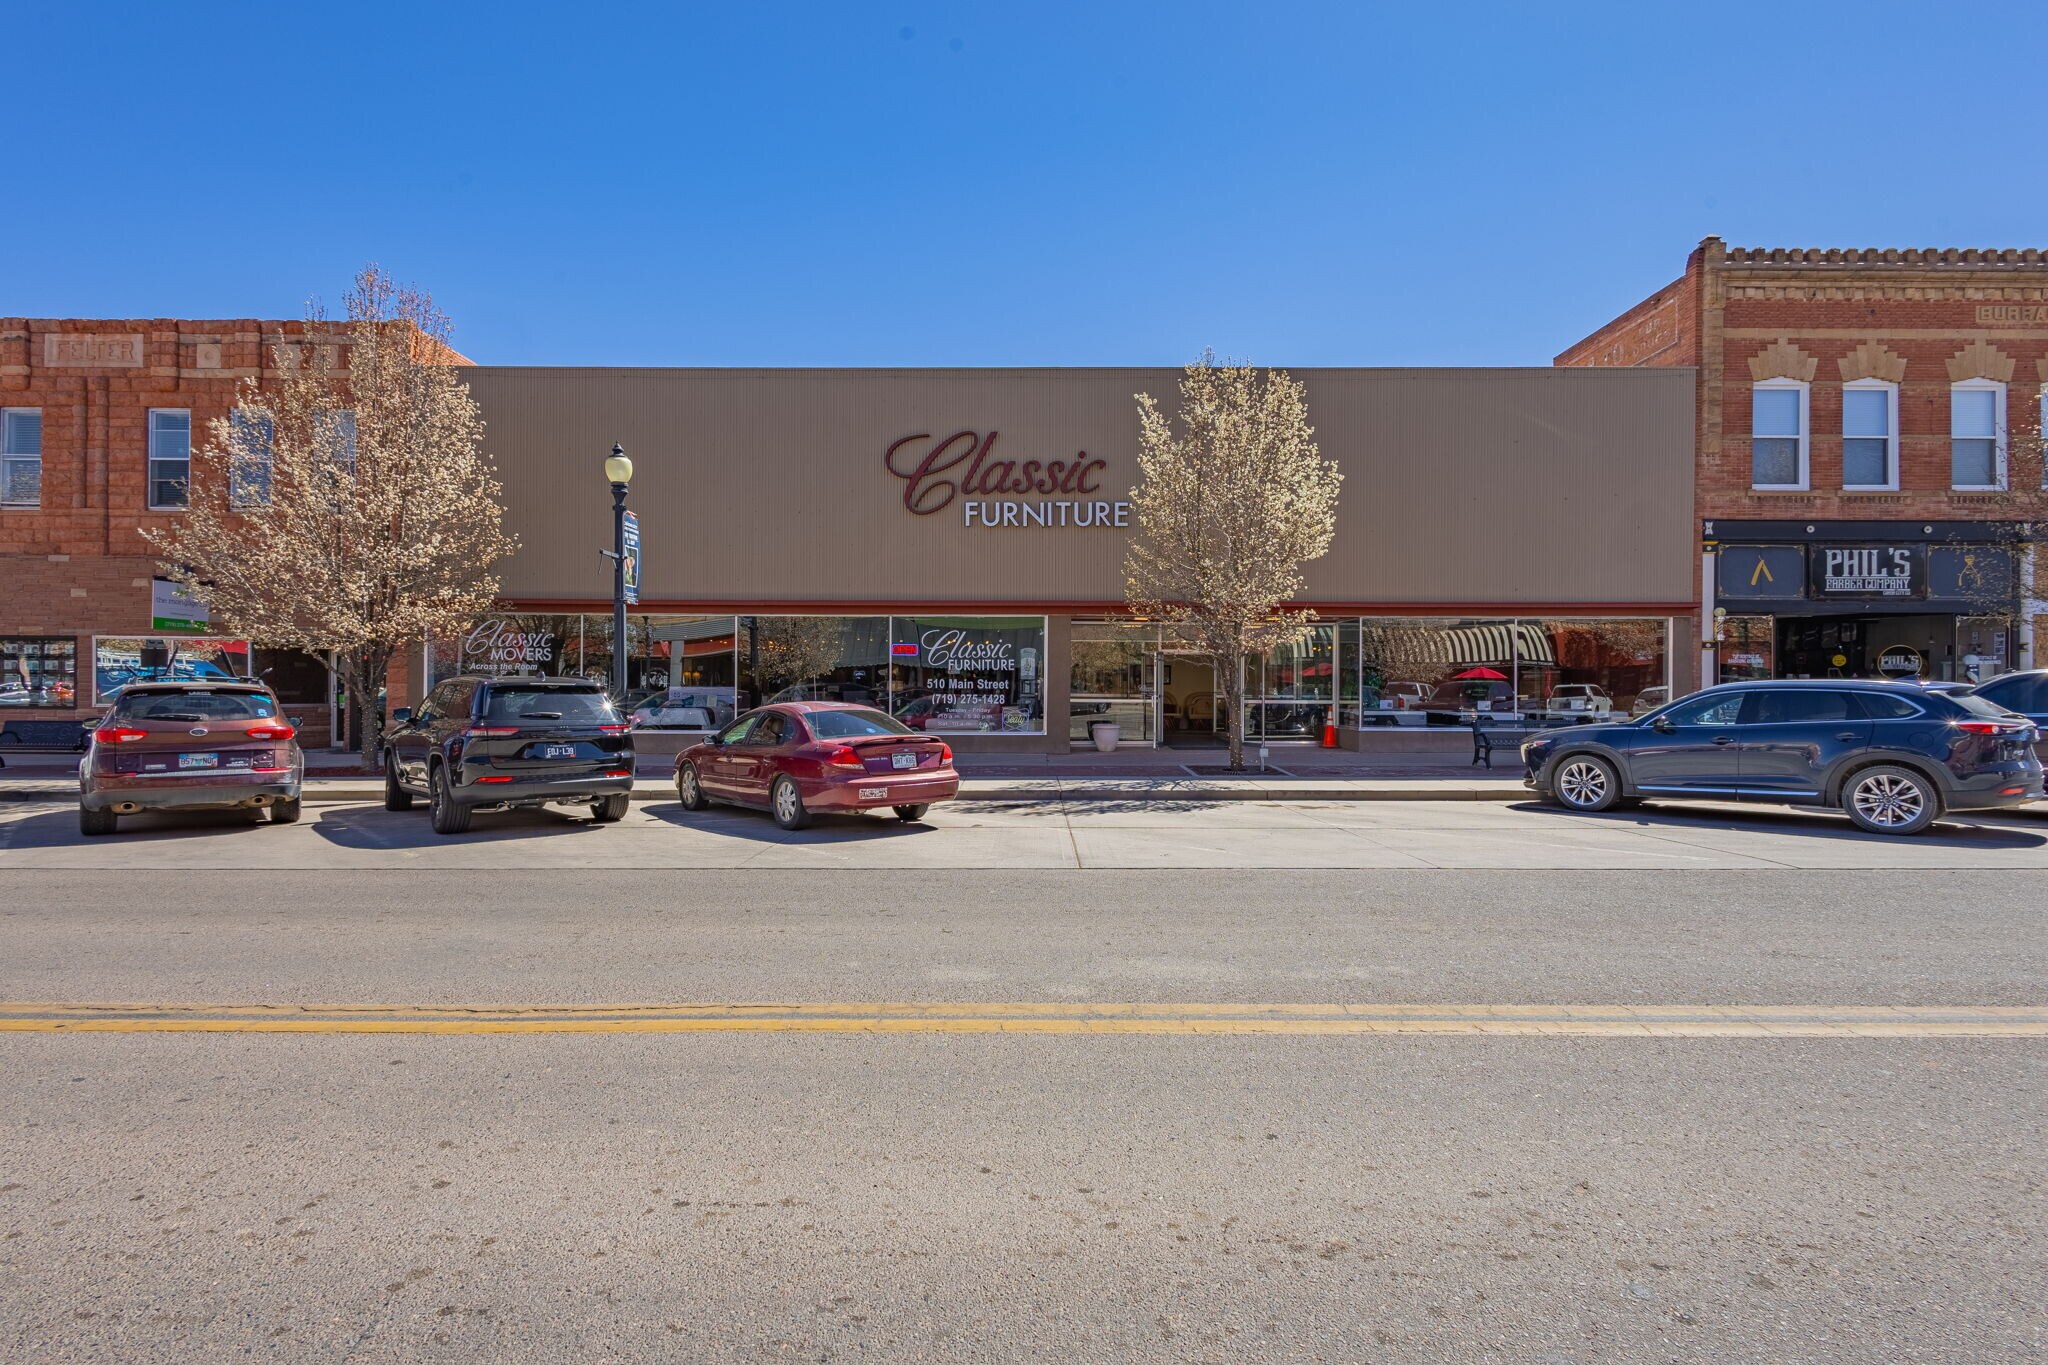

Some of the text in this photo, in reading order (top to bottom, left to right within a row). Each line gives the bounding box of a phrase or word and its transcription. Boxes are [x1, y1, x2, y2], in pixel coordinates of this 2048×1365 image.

[57, 341, 134, 361] FELTER
[884, 430, 1107, 515] Classic
[964, 501, 1129, 528] FURNITURE
[1825, 548, 1911, 577] PHIL'S
[1826, 579, 1910, 589] BARBER COMPANY
[460, 619, 555, 654] Classic
[893, 645, 916, 655] OPEN
[922, 629, 1012, 666] Classic
[491, 647, 552, 661] MOVERS
[1881, 655, 1919, 665] PHIL'S
[470, 662, 498, 670] Across
[500, 662, 513, 670] the
[949, 660, 1015, 671] FURNITURE
[927, 680, 1010, 690] 510 Main Street
[932, 695, 1006, 706] (719) 275-1428
[1005, 713, 1025, 725] Sealy
